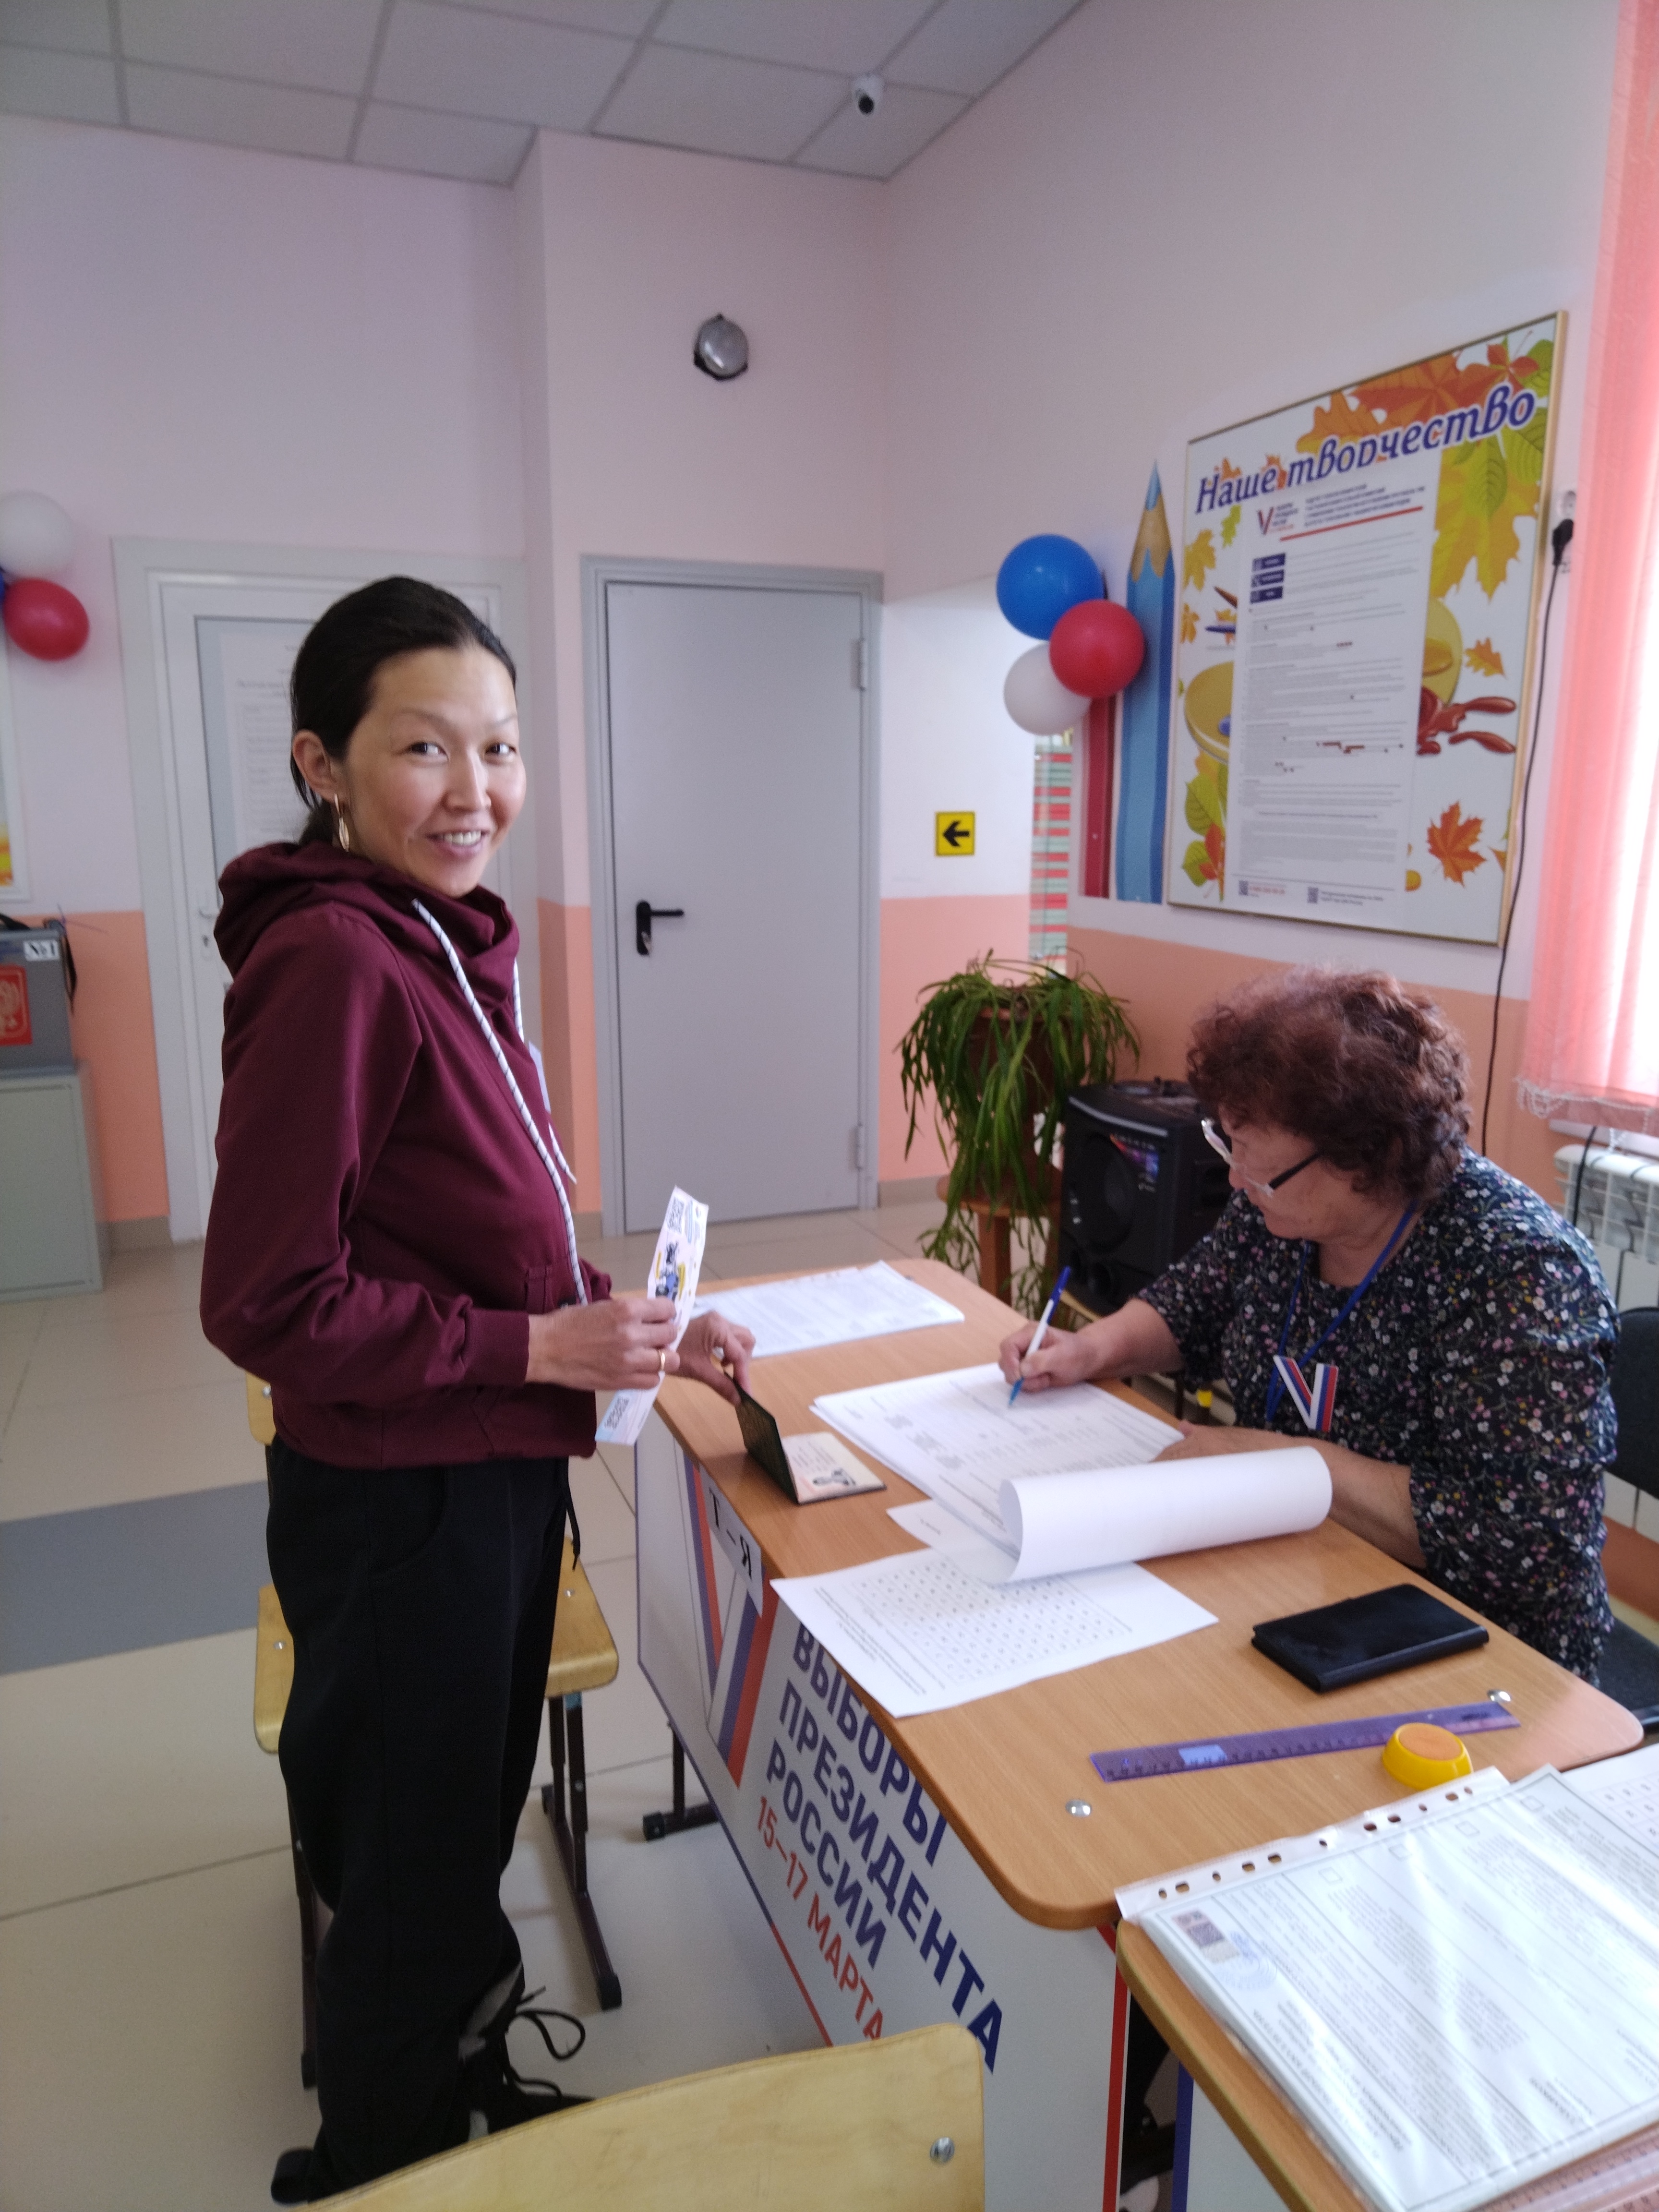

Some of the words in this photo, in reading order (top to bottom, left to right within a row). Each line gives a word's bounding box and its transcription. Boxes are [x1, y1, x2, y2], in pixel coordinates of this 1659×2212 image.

[1195, 468, 1277, 516] Наше
[1286, 384, 1536, 487] творчество
[766, 1737, 887, 1970] РОССИИ
[793, 1621, 948, 1867] ВЫБОРЫ
[779, 1678, 1003, 2076] ПРЕЗИДЕНТА
[807, 1891, 883, 2042] МАРТА
